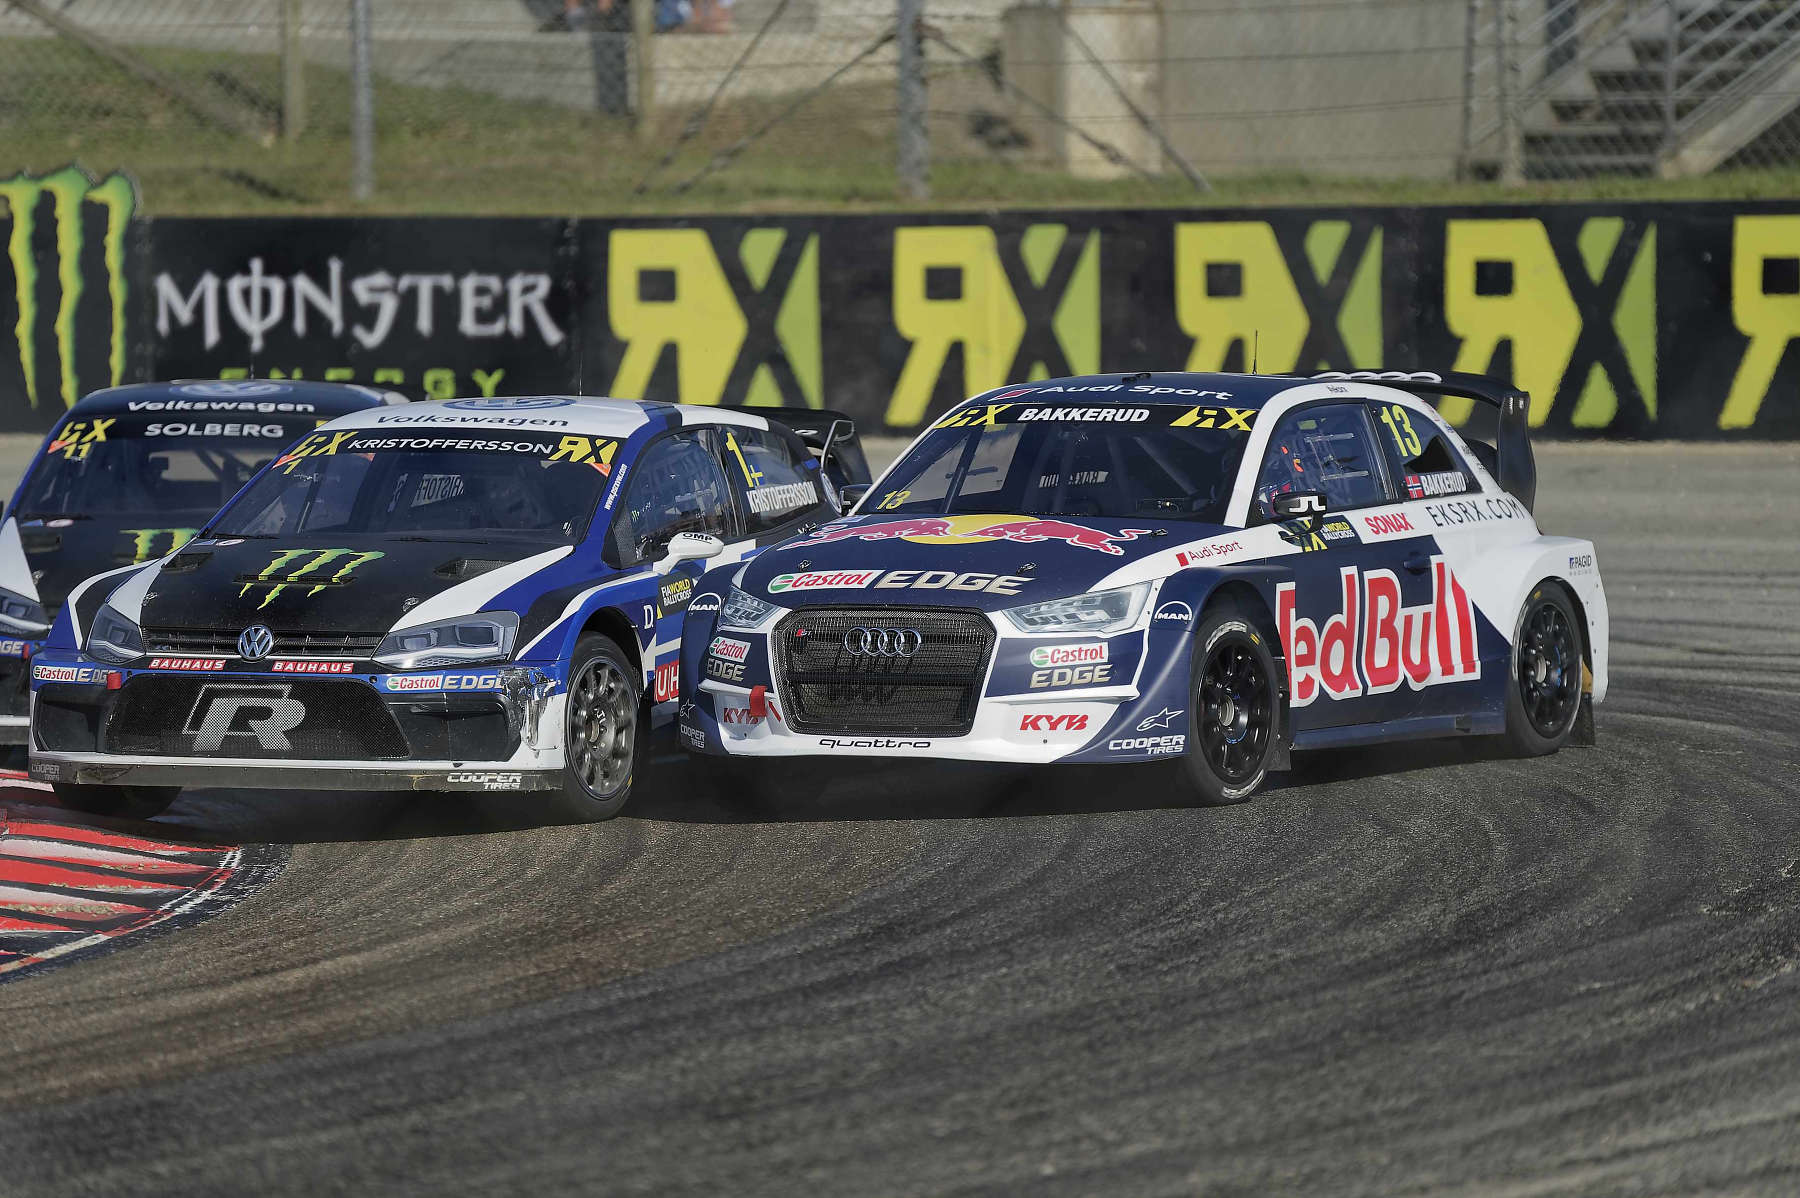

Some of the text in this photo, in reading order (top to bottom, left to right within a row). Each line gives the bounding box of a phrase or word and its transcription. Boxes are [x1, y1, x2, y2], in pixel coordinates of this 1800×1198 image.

[1043, 384, 1233, 401] Audi Sport
[128, 399, 315, 413] Volkswagen
[376, 414, 569, 428] Volkswagen
[1017, 407, 1150, 423] BAKKERUD
[144, 423, 284, 438] SOLBERG
[1381, 404, 1422, 457] 13
[347, 437, 553, 454] KRISTOFFERSSON
[876, 490, 911, 510] 13
[1426, 498, 1525, 527] EKSRX.COM
[1364, 512, 1415, 535] SONAX
[682, 532, 713, 542] OMP
[1190, 542, 1243, 562] Audi Sport
[791, 570, 1035, 595] Castrol EDGE
[716, 639, 747, 659] Castrol
[1050, 645, 1105, 664] Castrol
[150, 659, 225, 670] BAUHAUS
[273, 661, 353, 673] BAUHAUS
[706, 658, 748, 682] EDGE
[40, 667, 75, 681] Castrol
[1030, 663, 1113, 689] EDGE
[400, 676, 441, 690] Castrol
[1020, 714, 1089, 731] KYB
[680, 724, 705, 741] COOPER
[819, 738, 931, 750] quattro
[1109, 735, 1185, 751] COOPER
[1146, 744, 1184, 755] TIRES
[447, 772, 522, 783] COOPER
[484, 782, 520, 790] TIRES
